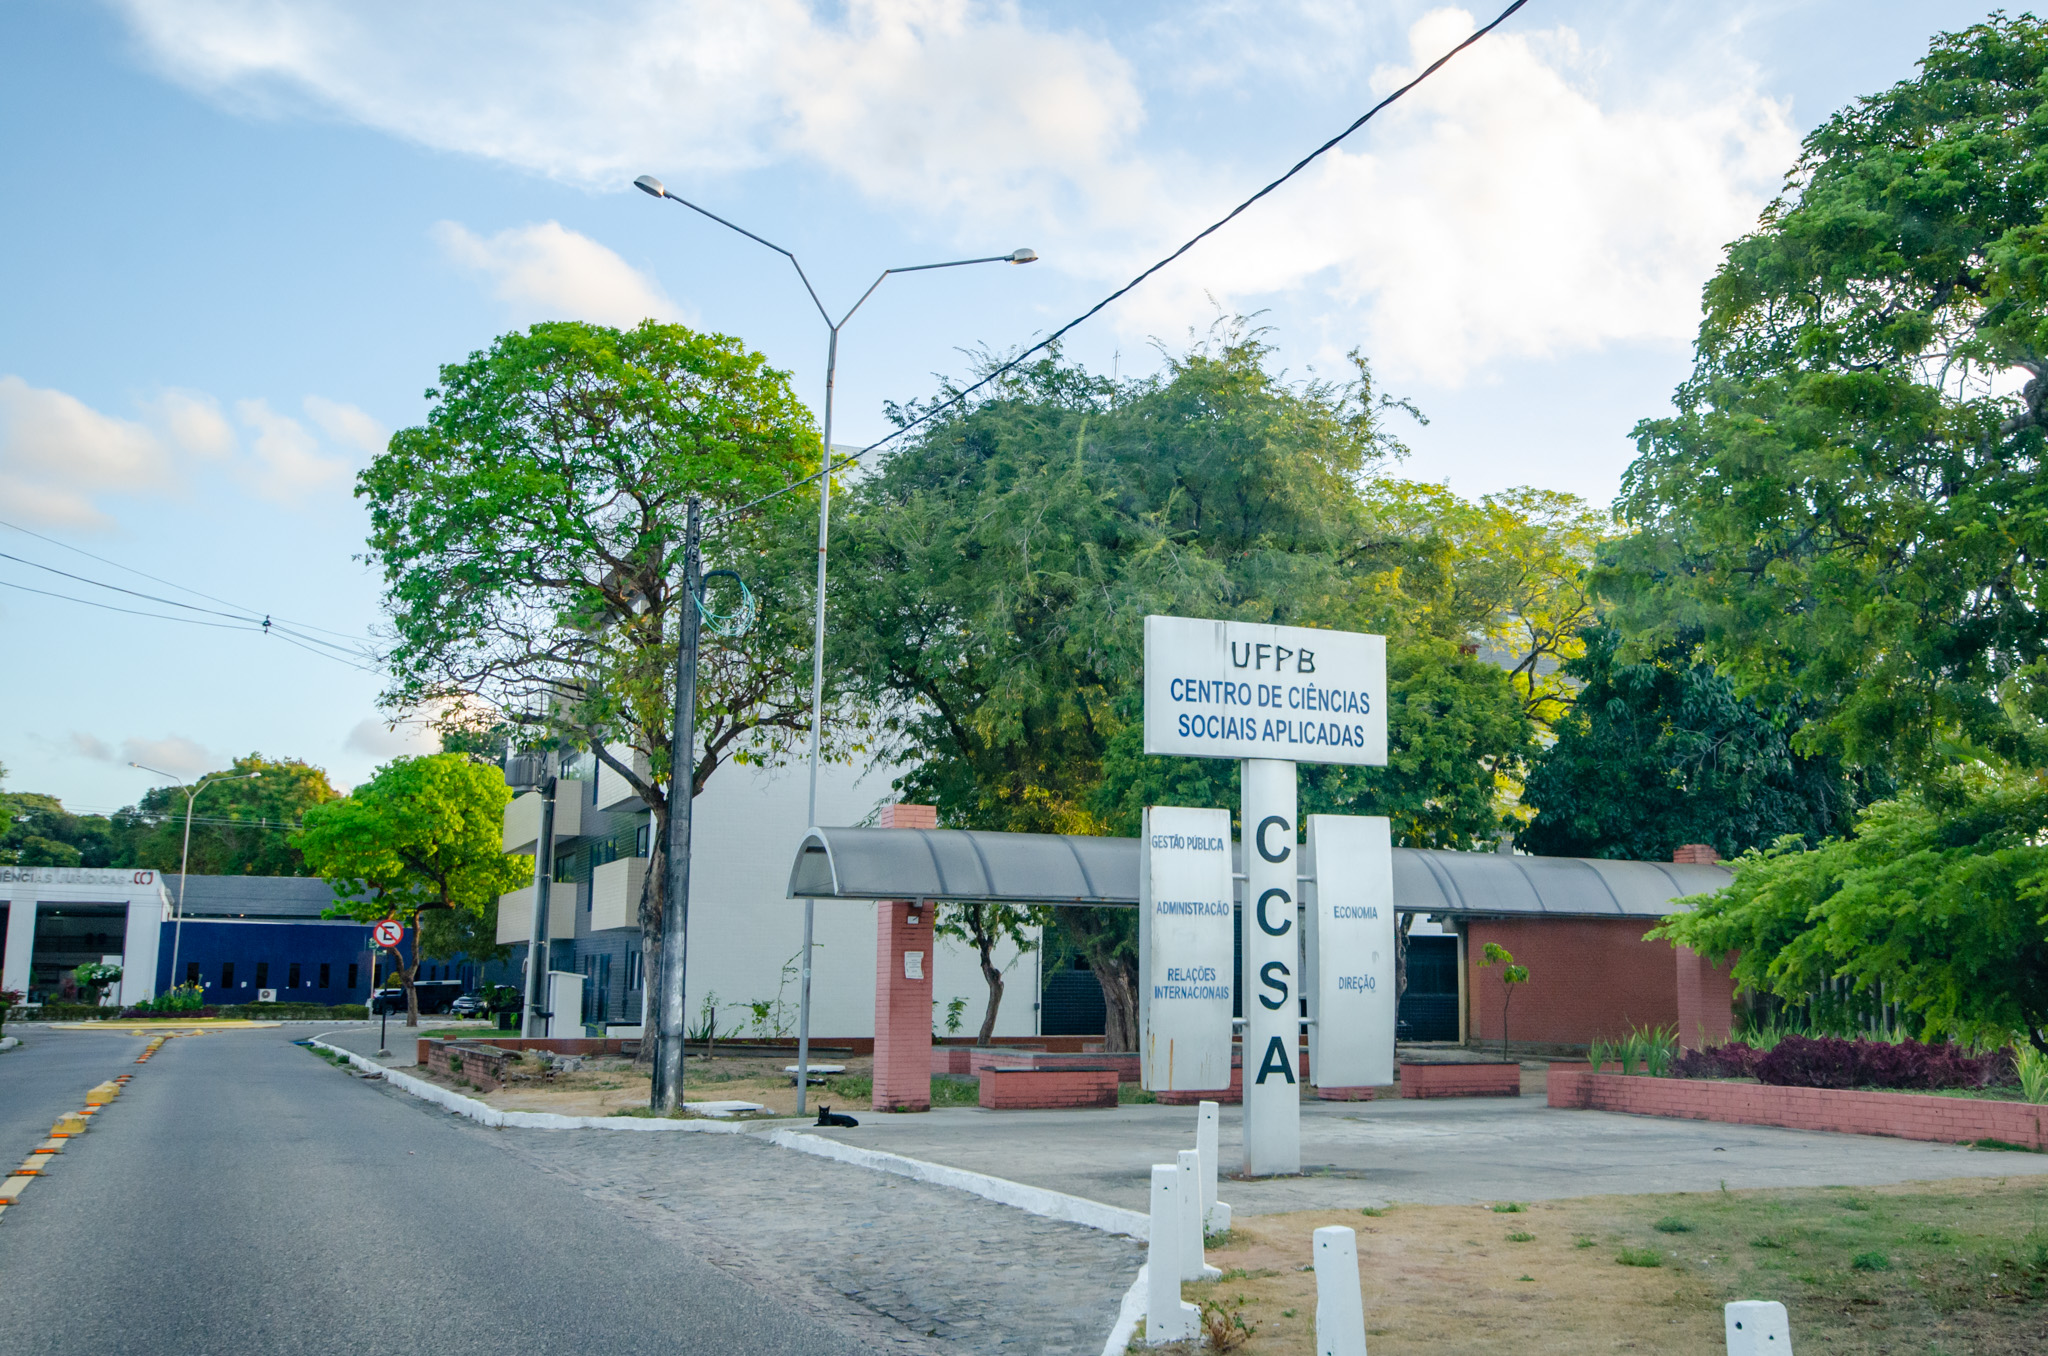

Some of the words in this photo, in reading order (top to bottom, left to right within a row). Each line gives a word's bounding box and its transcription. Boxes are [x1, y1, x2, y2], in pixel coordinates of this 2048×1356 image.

[1231, 641, 1316, 673] UFPB
[1170, 678, 1252, 706] CENTRO
[1258, 684, 1282, 708] DE
[1288, 682, 1370, 715] CIÊNCIAS
[1178, 713, 1257, 741] SOCIAIS
[1262, 719, 1365, 748] APLICADAS
[1152, 834, 1185, 850] GESTÃO
[1187, 834, 1224, 852] PÚBLICA
[1333, 905, 1378, 920] ECONOMIA
[1255, 815, 1296, 1085] CCSA
[1167, 966, 1216, 985] RELAÇÕES
[1338, 973, 1376, 994] DIREÇÃO
[1154, 985, 1230, 1000] INTERNACIONAIS
